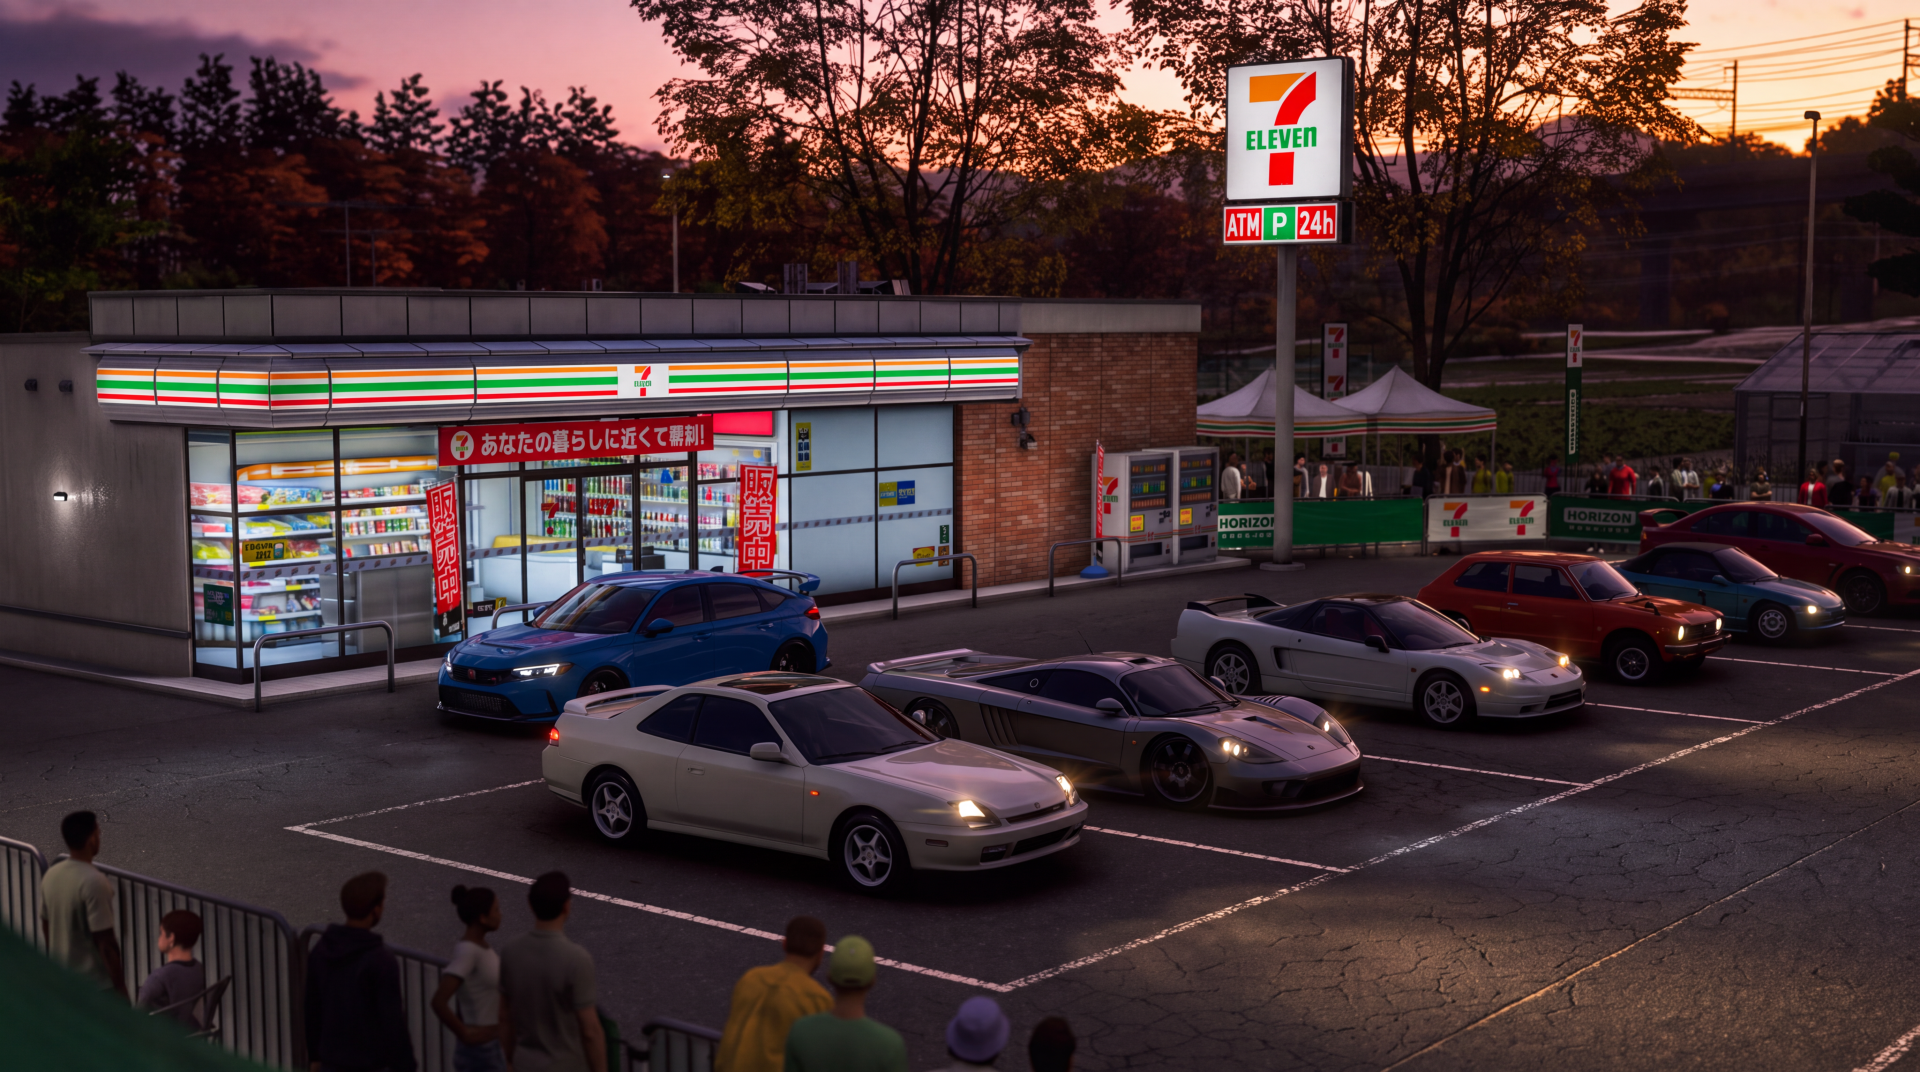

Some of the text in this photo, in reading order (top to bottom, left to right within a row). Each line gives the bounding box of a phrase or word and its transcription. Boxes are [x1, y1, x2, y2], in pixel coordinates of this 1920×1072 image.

[1249, 71, 1317, 186] 7
[1227, 209, 1333, 237] ATM P 24h
[634, 366, 651, 397] 7
[1568, 510, 1631, 523] HORIZON
